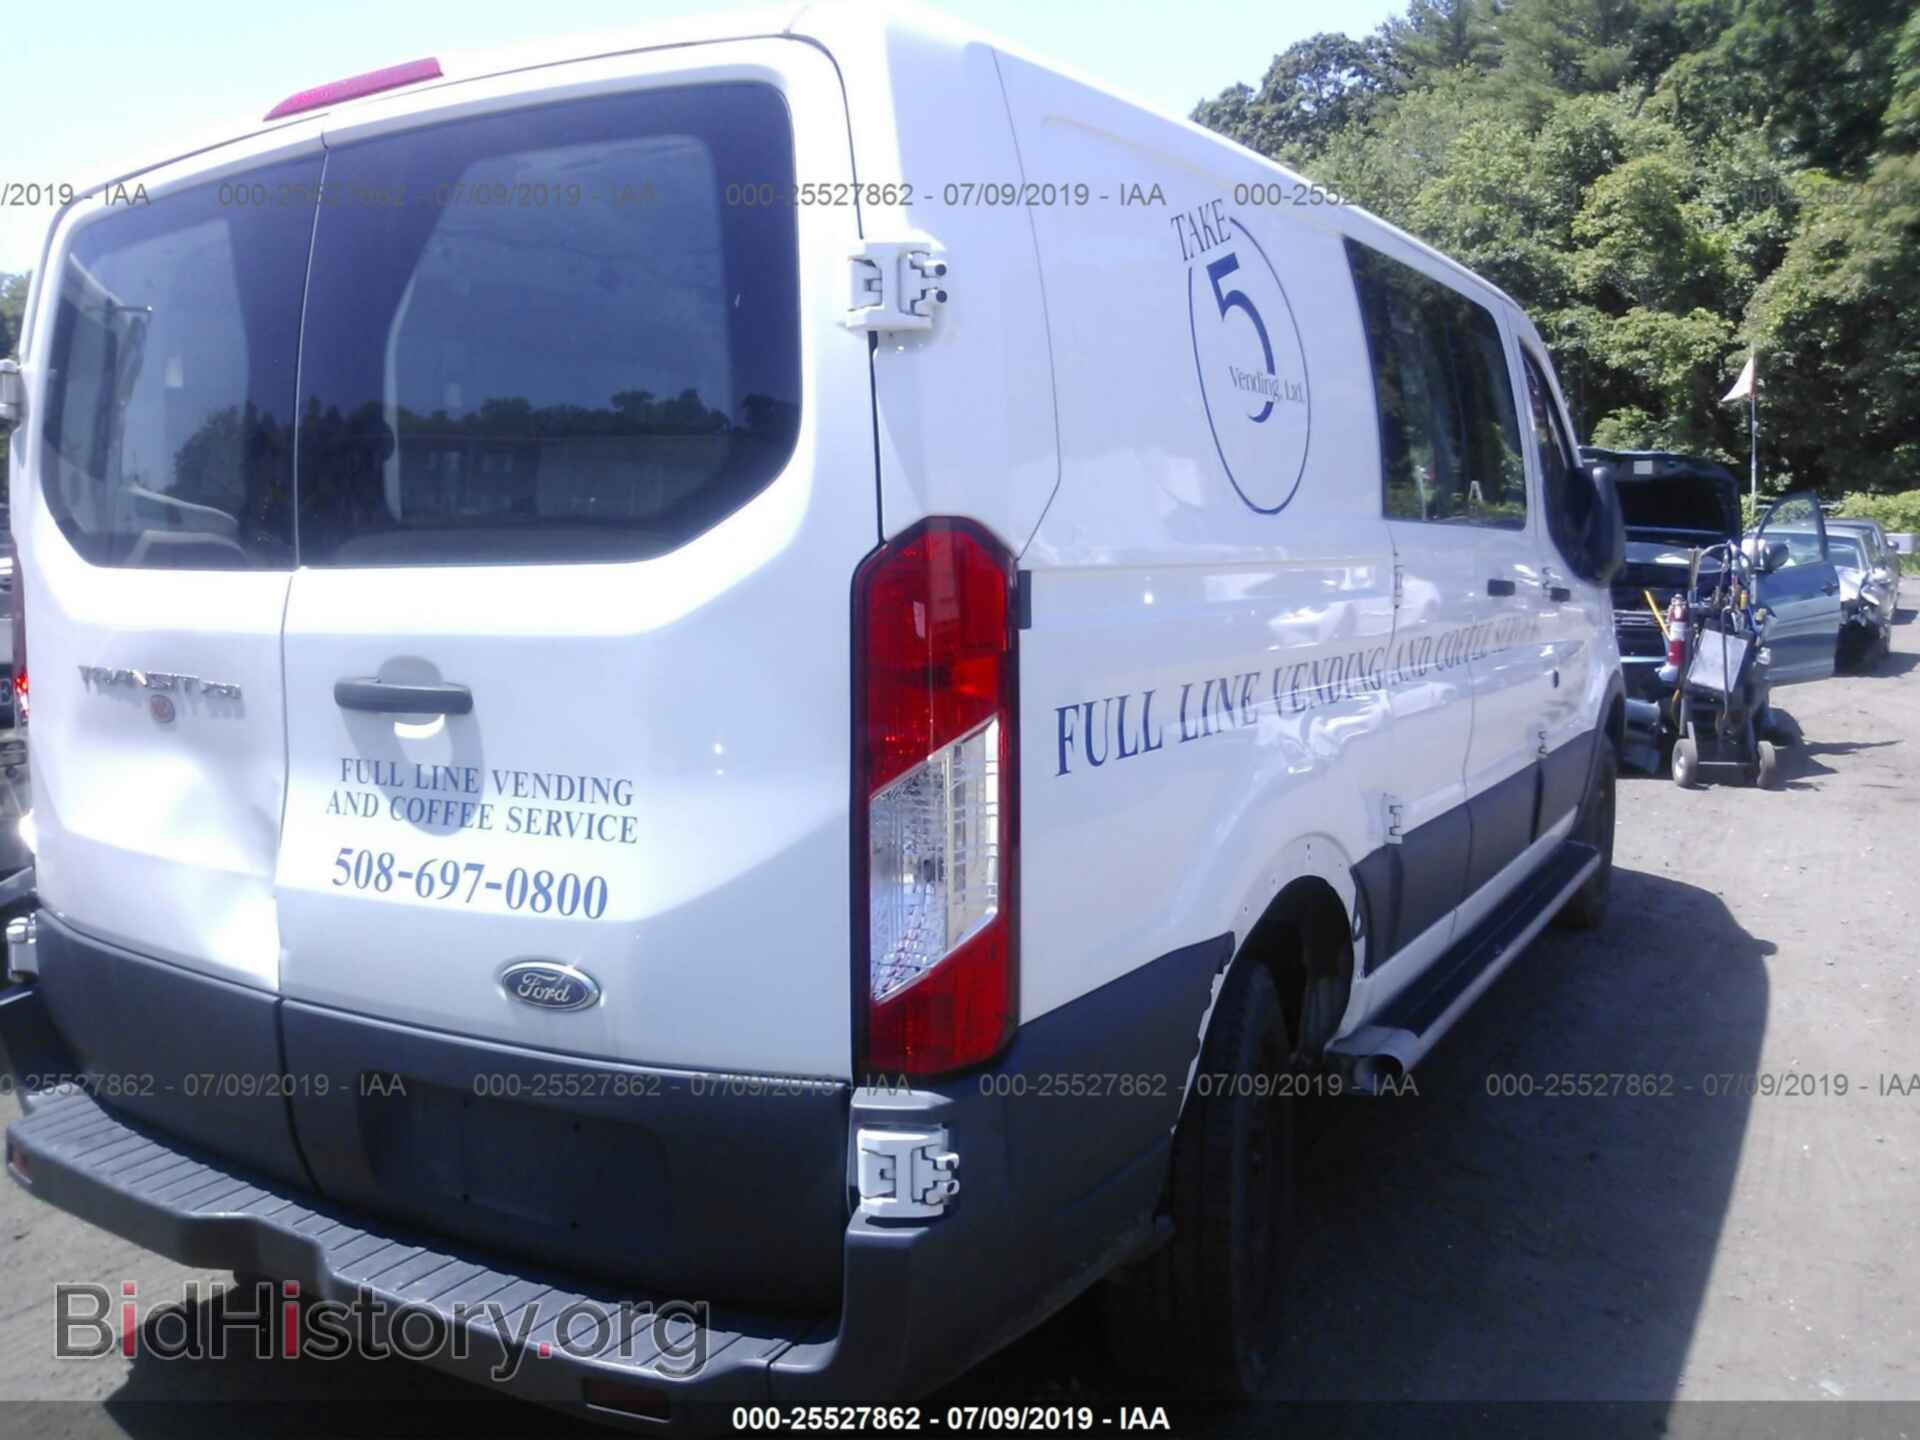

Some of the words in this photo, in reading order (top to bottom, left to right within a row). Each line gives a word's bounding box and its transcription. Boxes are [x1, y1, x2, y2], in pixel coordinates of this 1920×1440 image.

[1171, 199, 1232, 262] TAKE
[1206, 252, 1276, 423] 5
[1055, 689, 1163, 777] FULL
[1179, 671, 1261, 744] LINE
[1272, 646, 1386, 717] VENDING
[340, 758, 403, 788] FULL
[415, 763, 480, 794] LINE
[492, 769, 634, 807] VENDING
[325, 790, 379, 818] AND
[389, 796, 495, 831] COFFEE
[506, 806, 639, 844] SERVICE
[331, 847, 609, 920] 508-697-0800
[516, 972, 572, 1002] Ford
